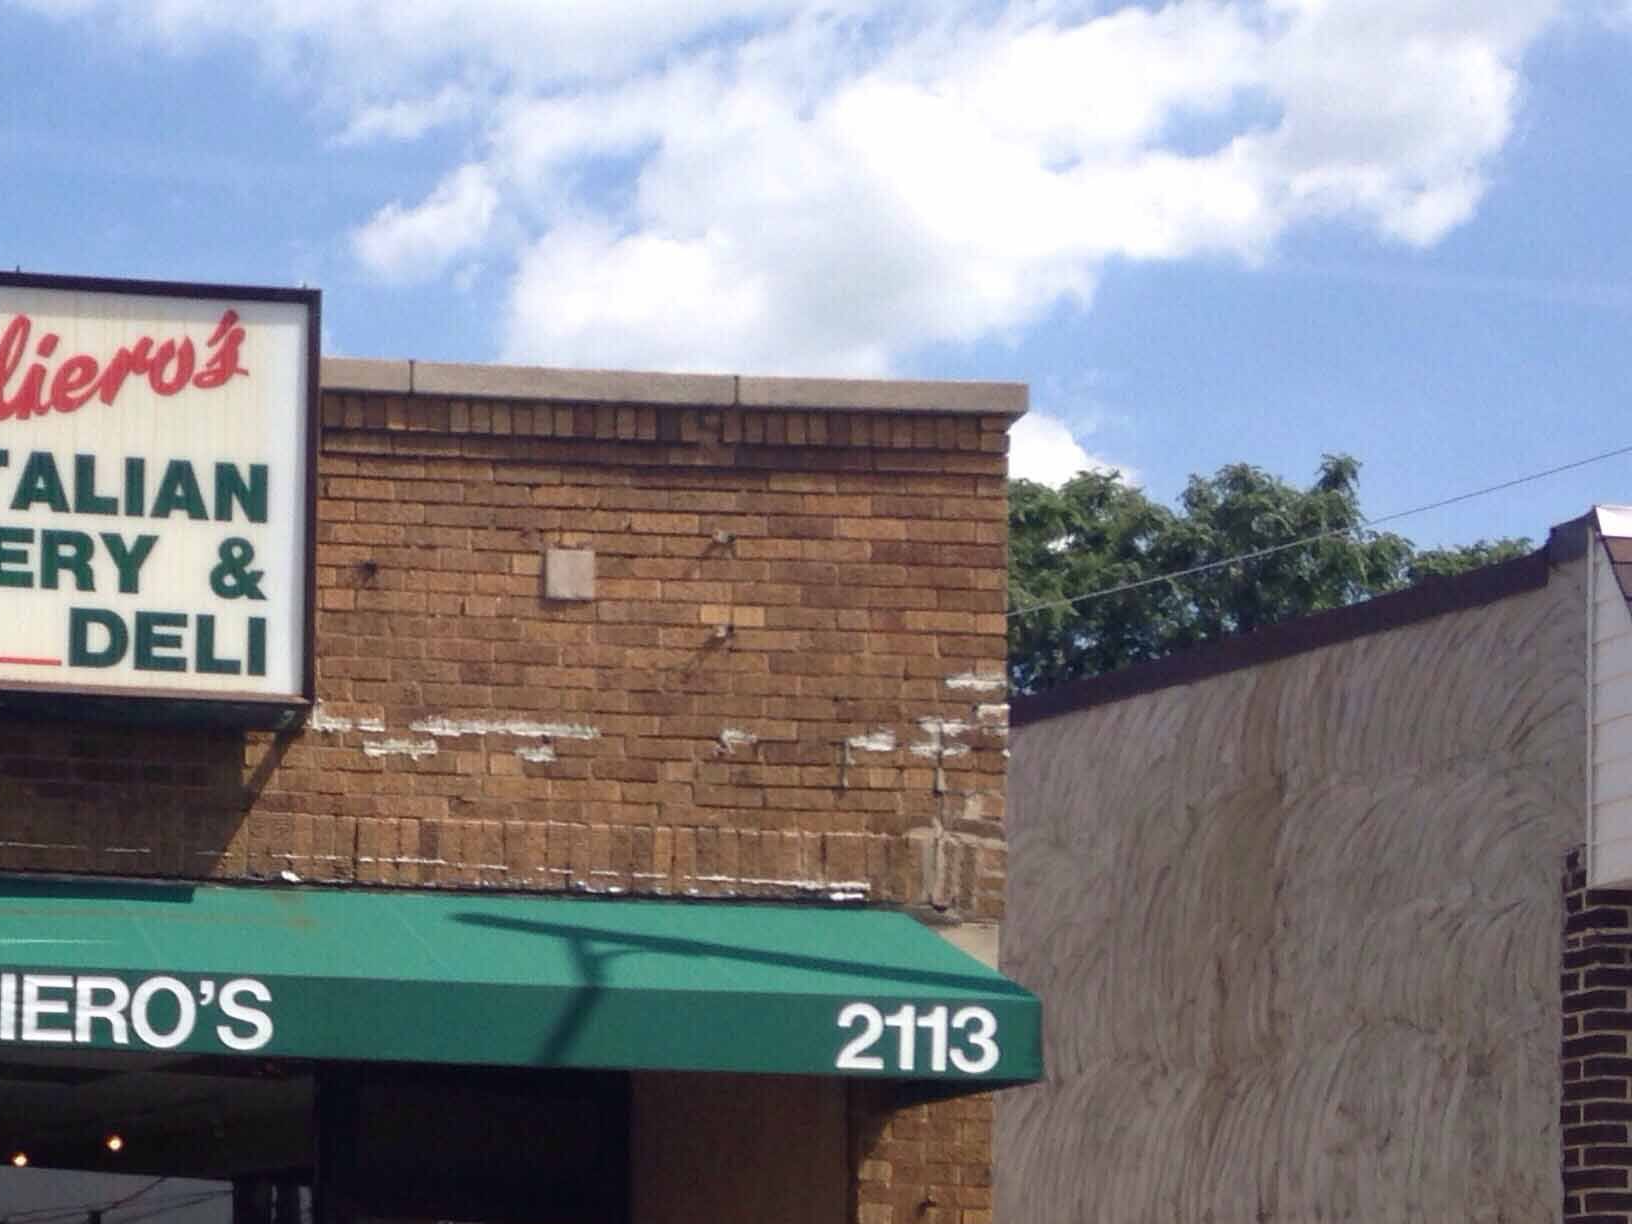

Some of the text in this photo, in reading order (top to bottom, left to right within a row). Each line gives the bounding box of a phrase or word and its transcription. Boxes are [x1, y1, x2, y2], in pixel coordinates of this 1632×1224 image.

[209, 536, 267, 600] &
[68, 606, 267, 677] DELI
[835, 1002, 1001, 1074] 2113
